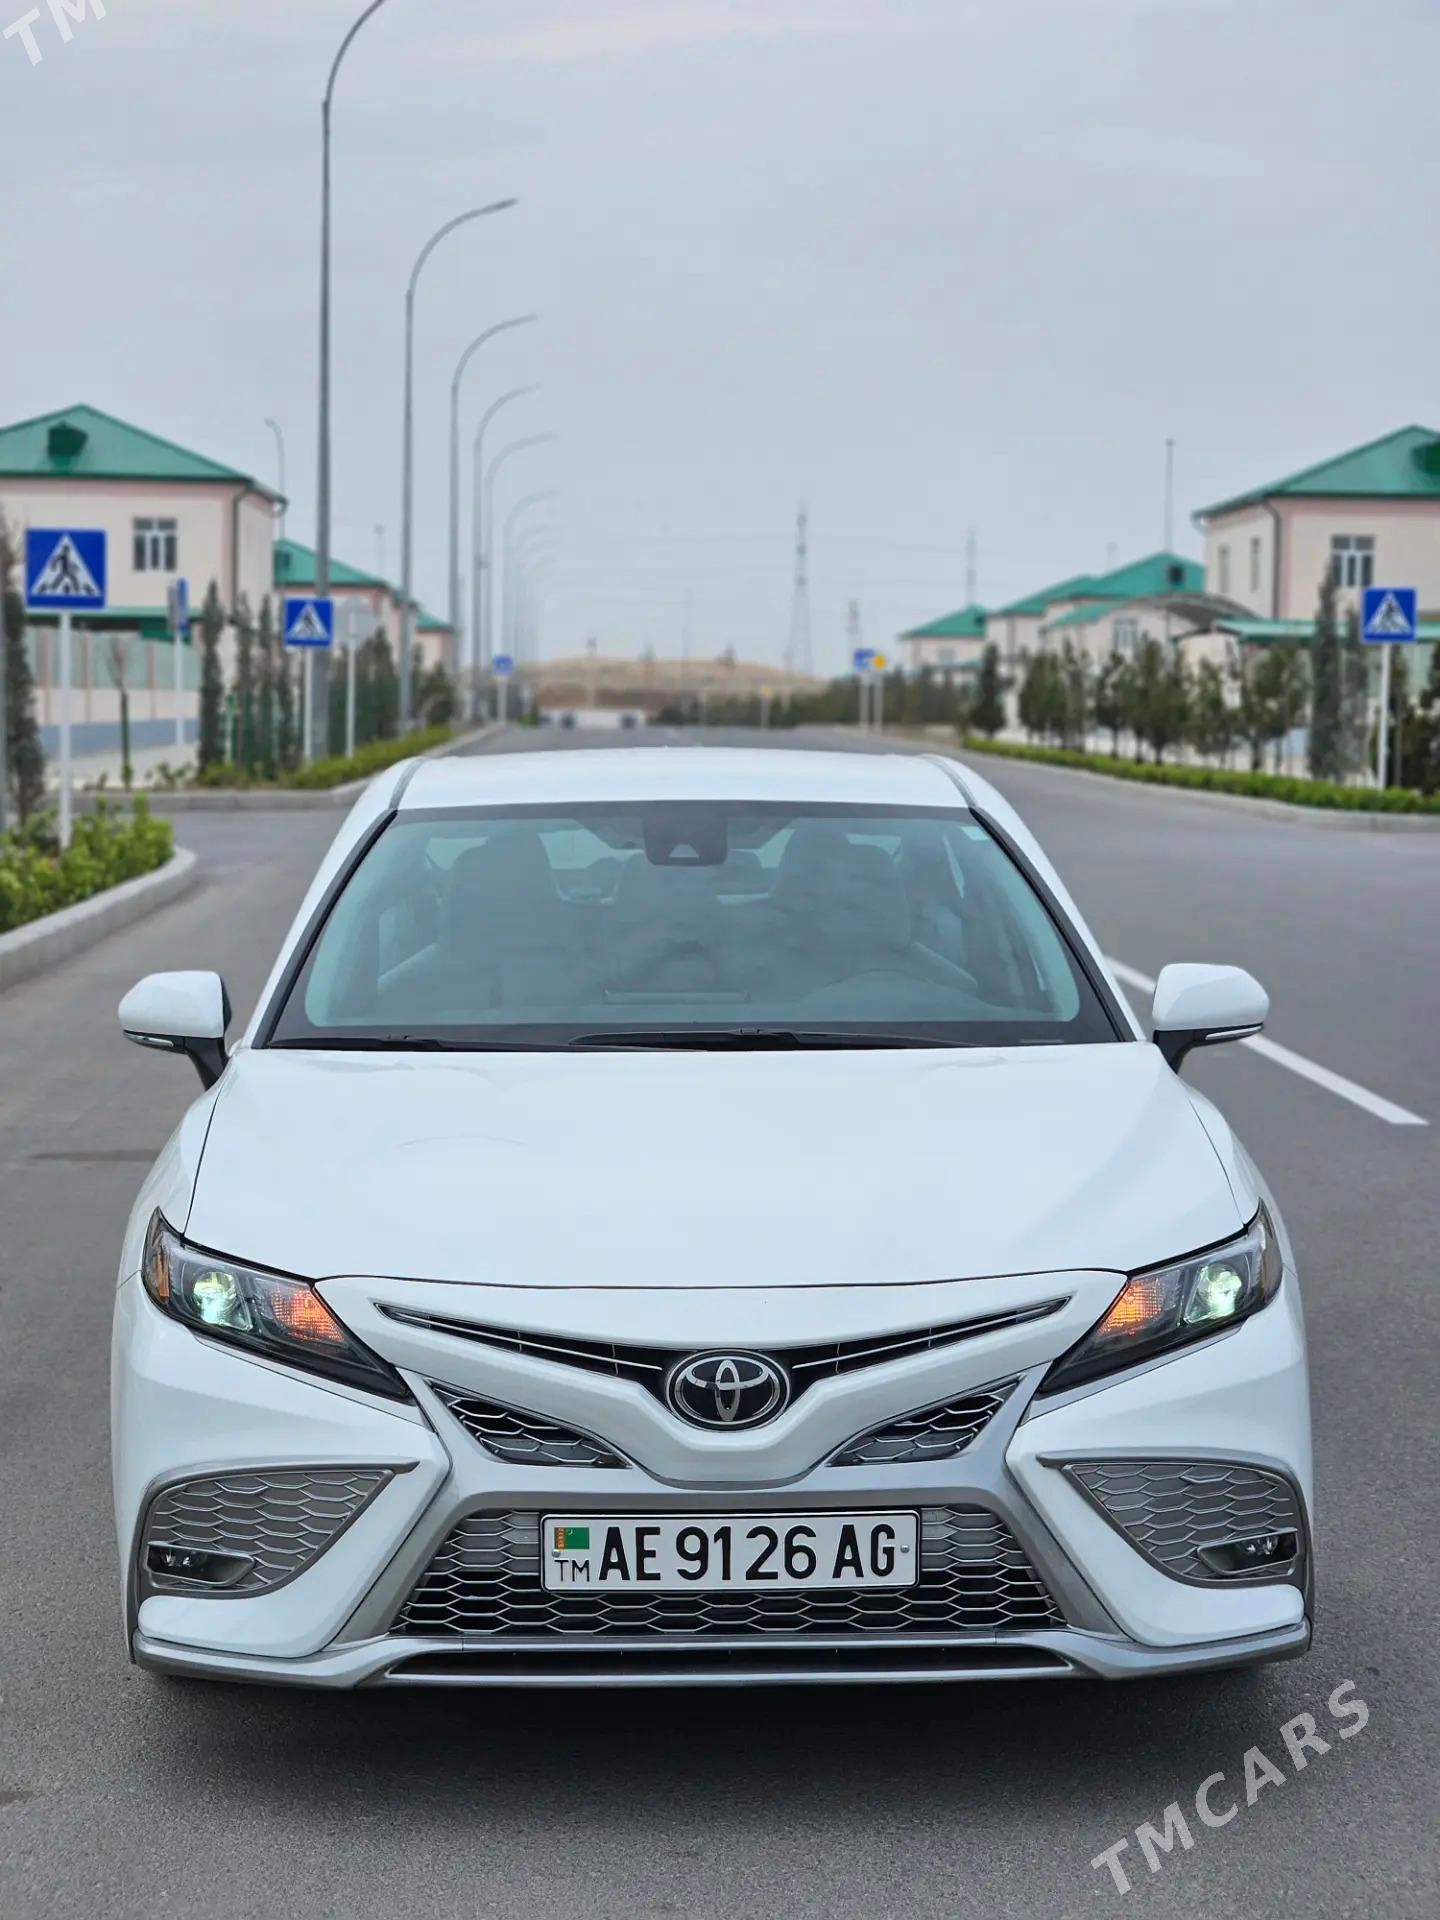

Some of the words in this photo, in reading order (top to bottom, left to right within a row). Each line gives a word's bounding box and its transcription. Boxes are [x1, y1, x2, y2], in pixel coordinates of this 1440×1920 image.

[554, 1559, 590, 1582] TM
[598, 1526, 662, 1581] AE
[675, 1525, 817, 1581] 9126
[832, 1523, 896, 1579] AG
